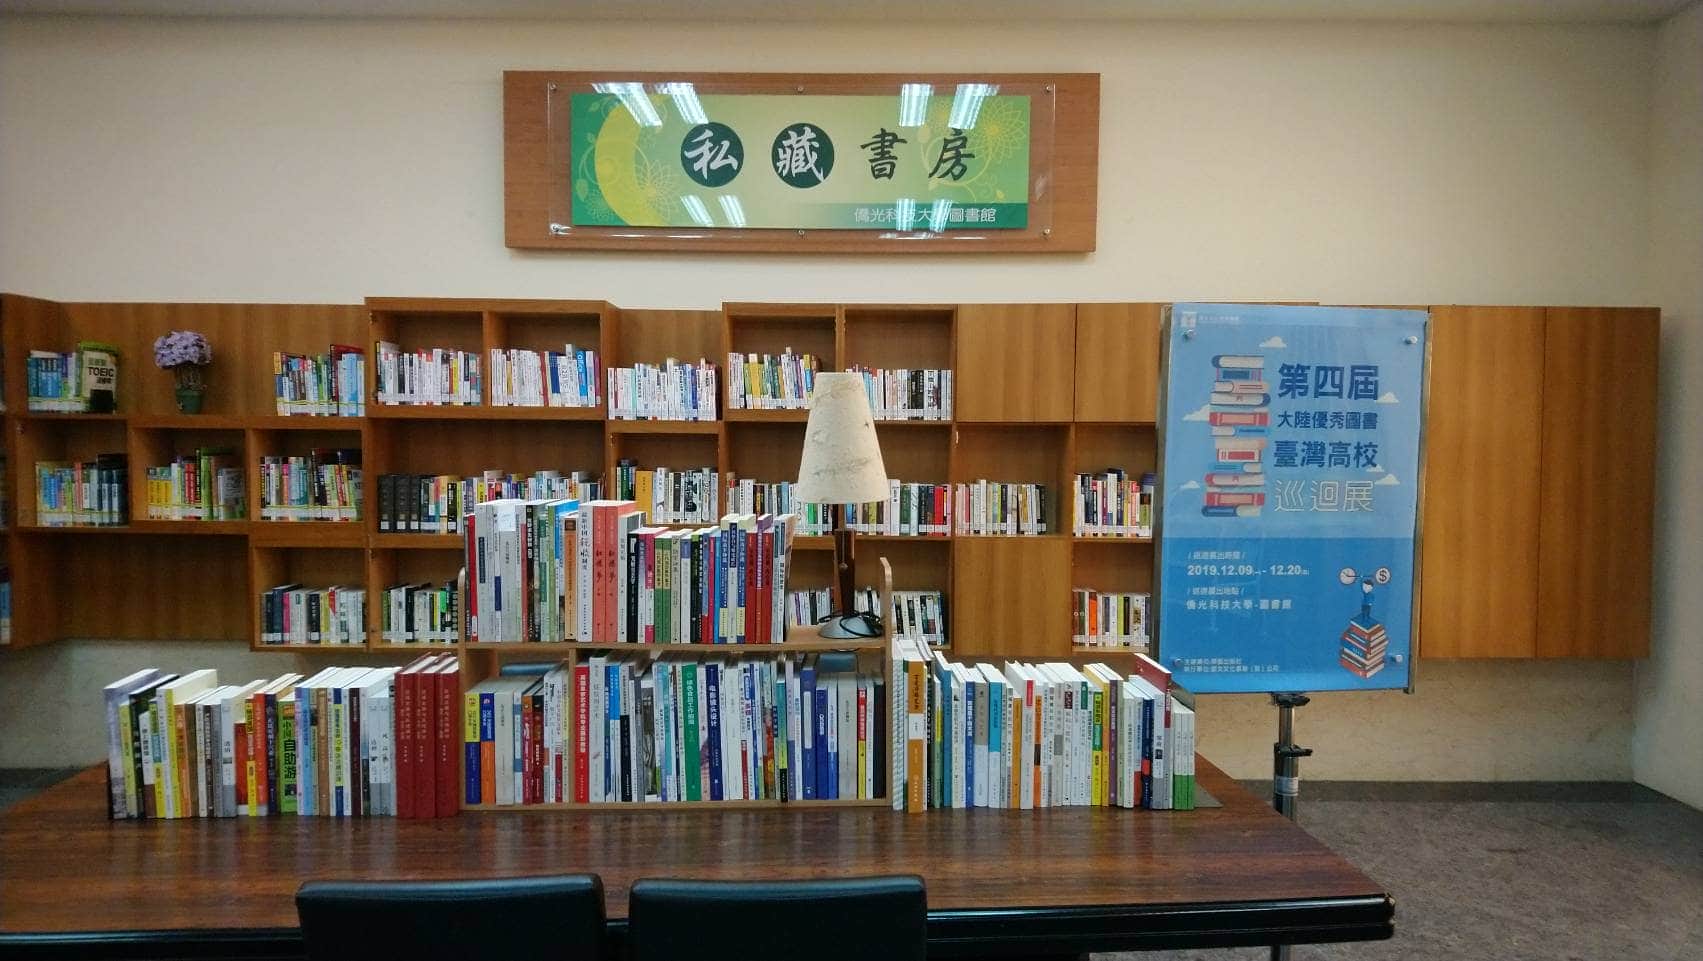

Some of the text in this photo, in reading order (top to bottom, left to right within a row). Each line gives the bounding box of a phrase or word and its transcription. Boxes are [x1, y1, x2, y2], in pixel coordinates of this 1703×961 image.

[854, 207, 996, 223] 僑光科大圖書館
[88, 366, 114, 377] TOEIC
[1277, 362, 1379, 401] 第四屆
[1277, 411, 1378, 430] 大陸優秀圖書
[1273, 439, 1379, 468] 臺灣高校
[1274, 480, 1375, 512] 巡迴展
